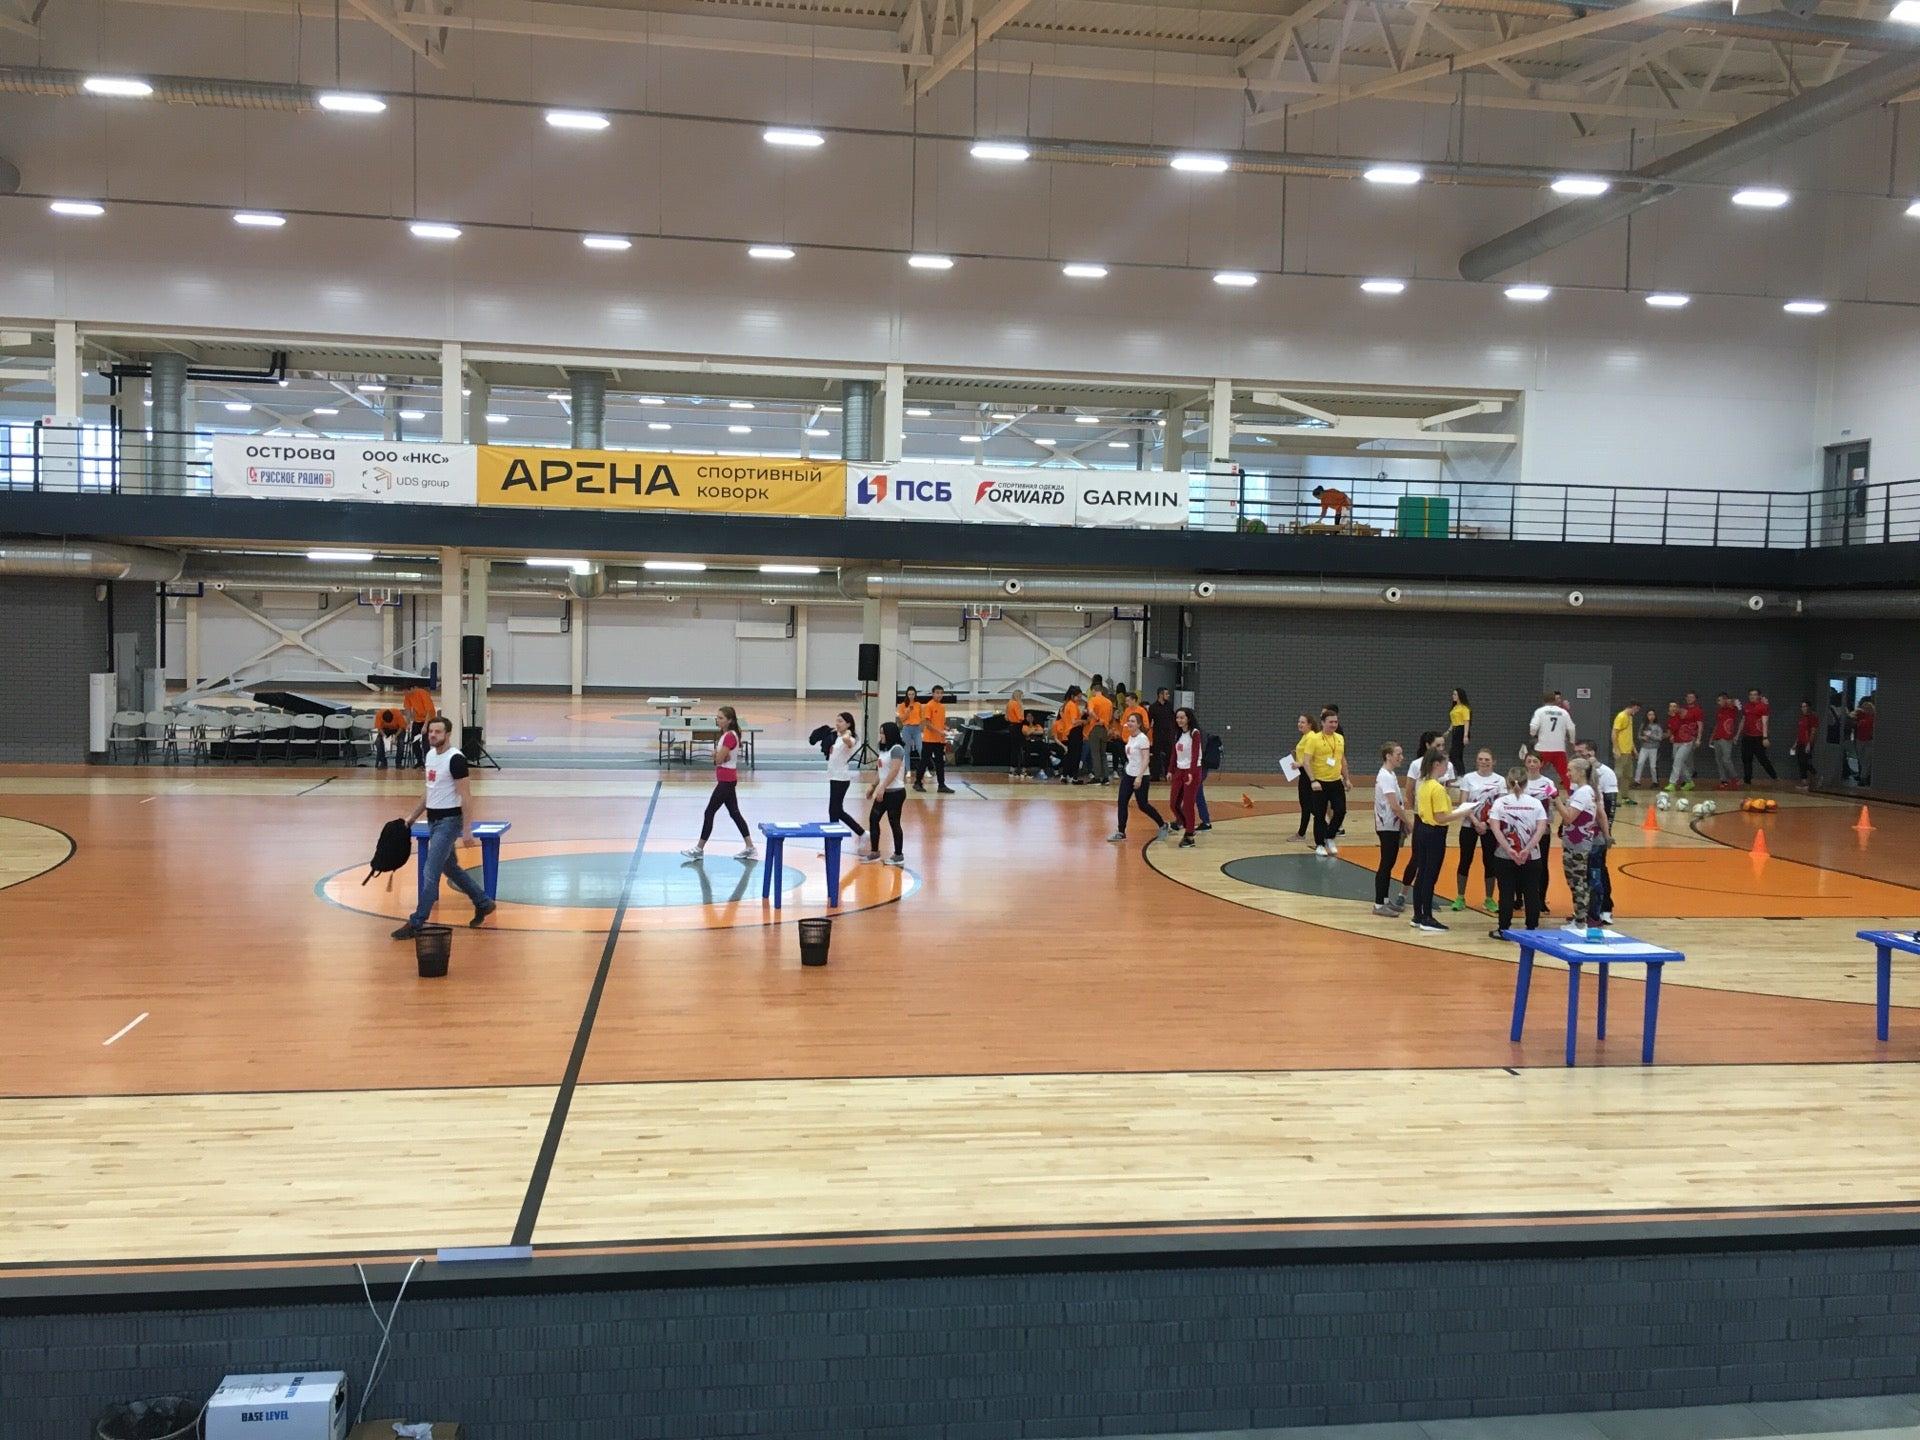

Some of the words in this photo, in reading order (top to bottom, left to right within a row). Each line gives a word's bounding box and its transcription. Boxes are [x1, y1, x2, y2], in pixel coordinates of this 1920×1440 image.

[246, 445, 335, 461] острова
[362, 450, 398, 463] ООО
[403, 451, 450, 464] «НКС»
[260, 471, 295, 484] РУССКОЕ
[501, 458, 681, 497] АРЕНА
[697, 464, 822, 483] спортивный
[396, 476, 419, 486] UDS
[421, 479, 450, 489] group
[998, 482, 1037, 490] СПОРТИВНАЯ
[697, 484, 770, 502] коворк
[896, 480, 952, 502] ПСБ
[975, 481, 1065, 506] FORWARD
[1083, 489, 1178, 507] GARMIN
[1550, 717, 1558, 732] 7
[241, 1411, 264, 1422] BASE
[265, 1410, 290, 1421] LEVEL
